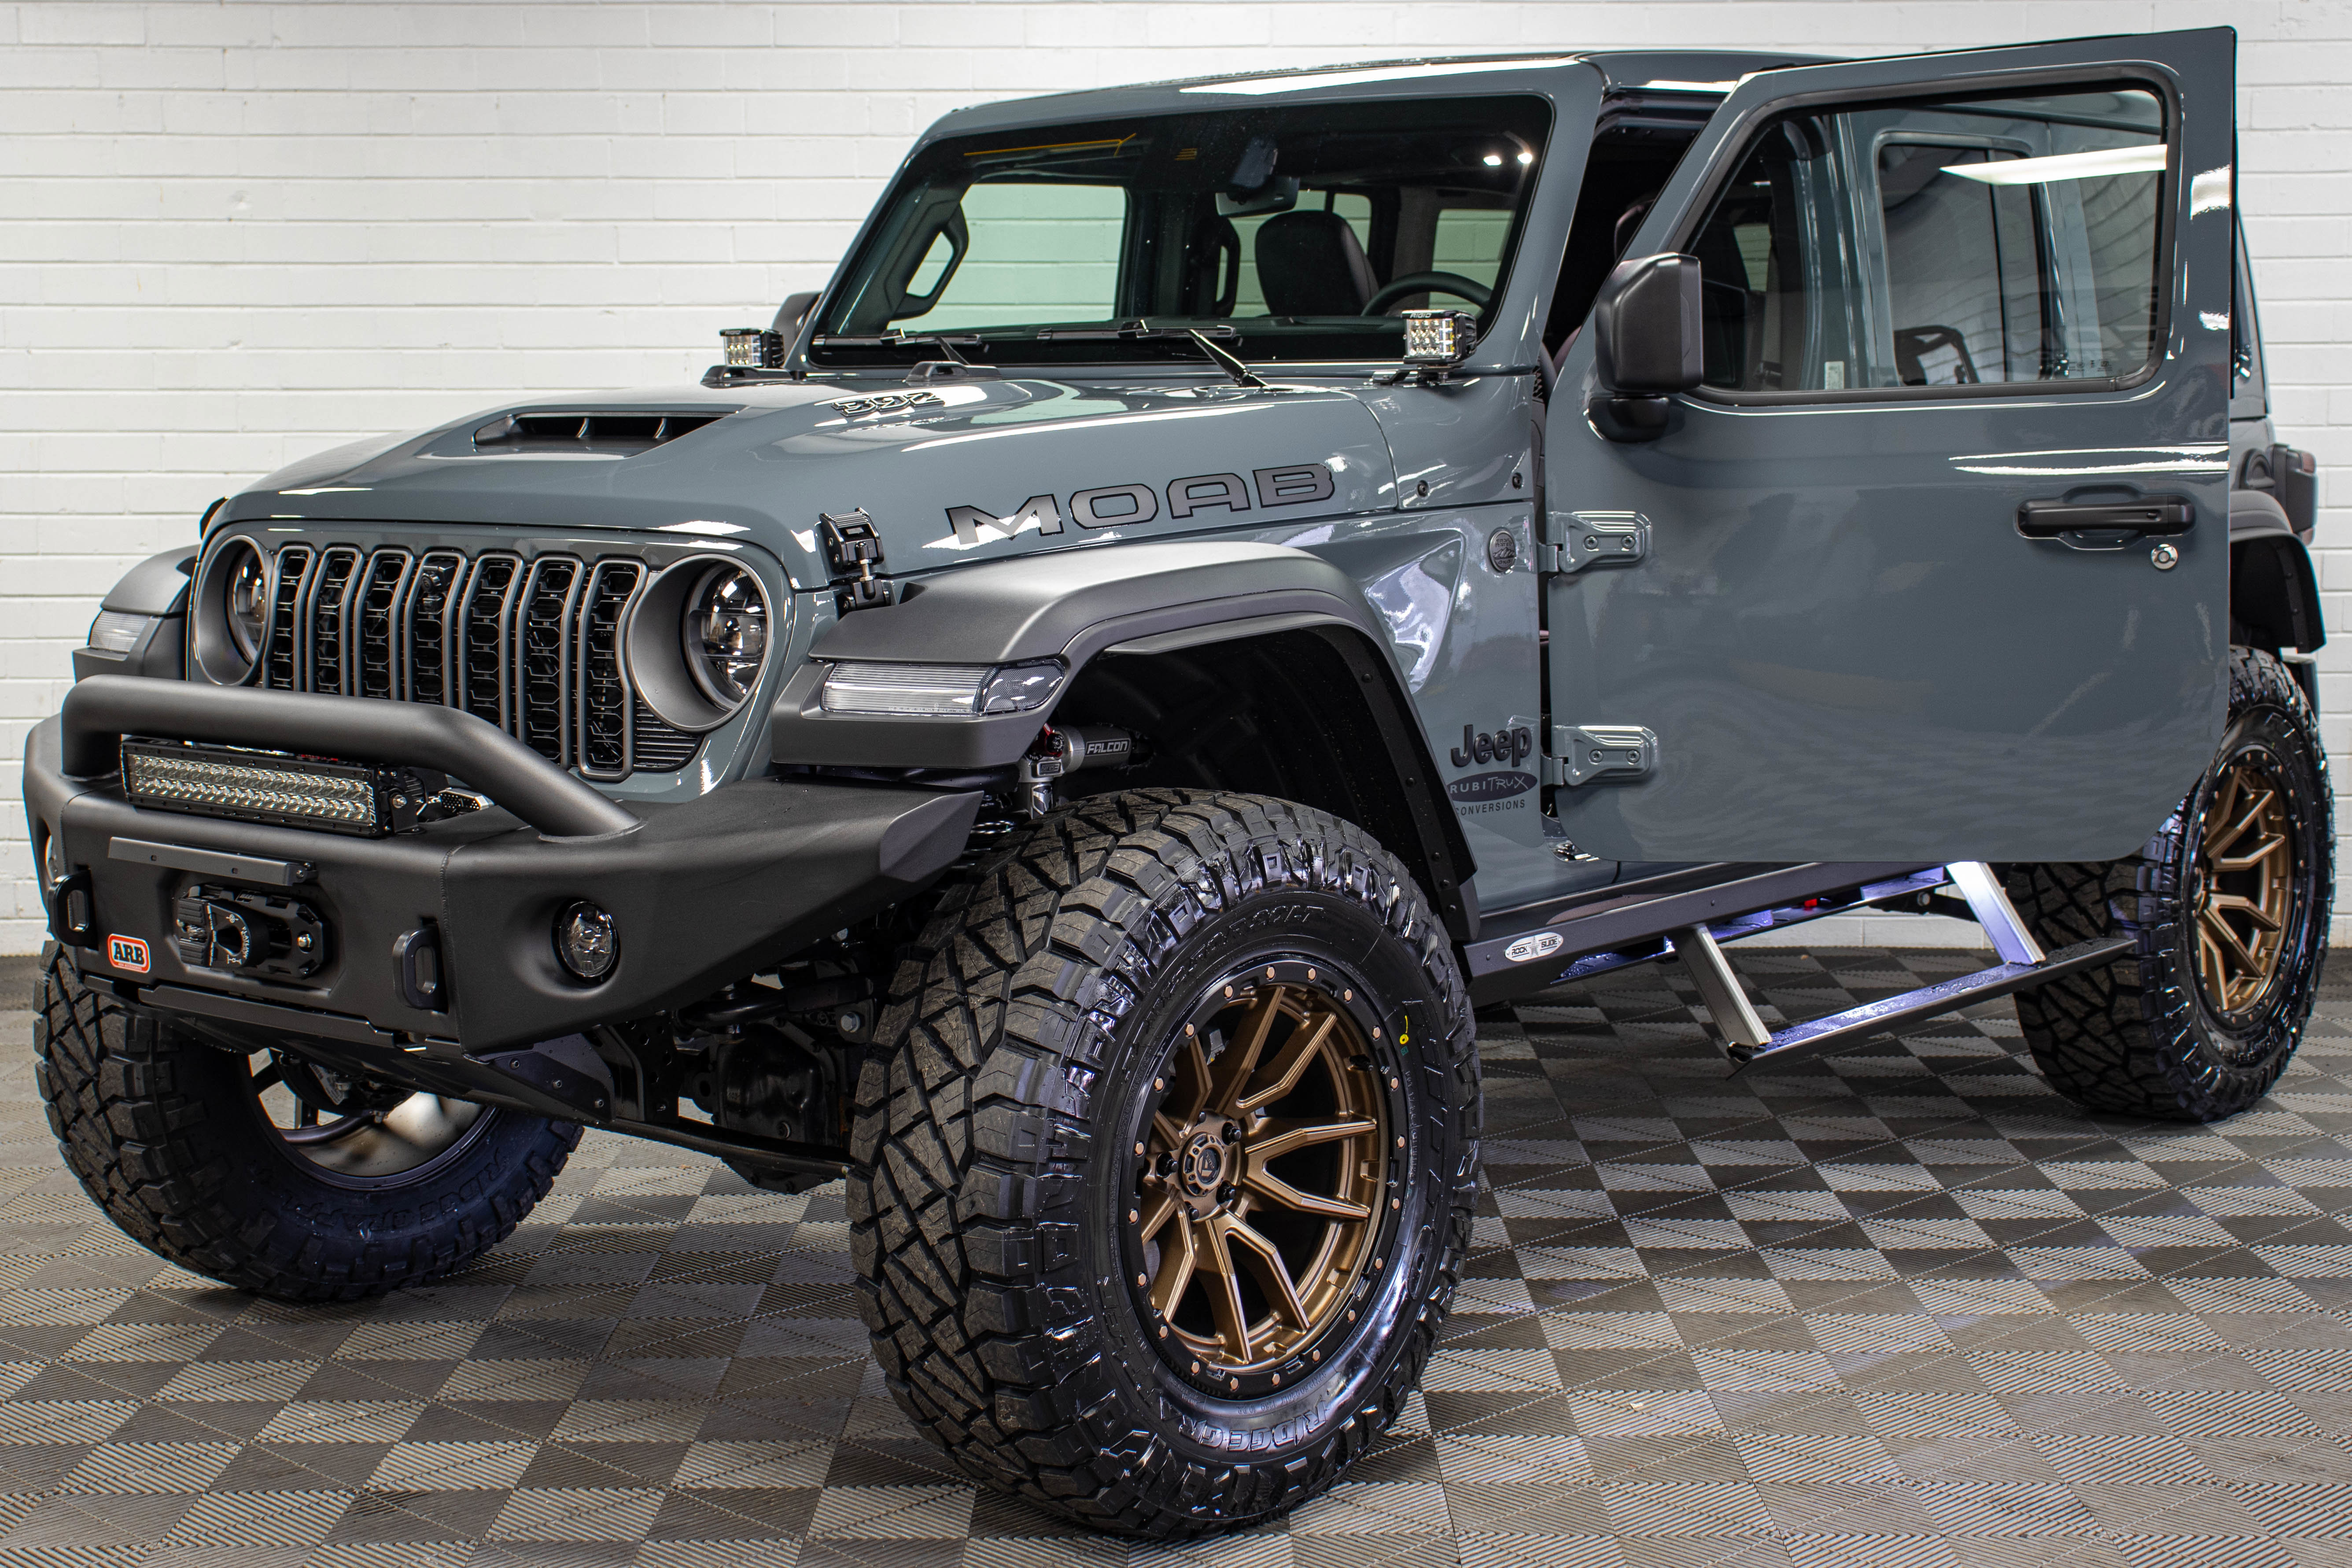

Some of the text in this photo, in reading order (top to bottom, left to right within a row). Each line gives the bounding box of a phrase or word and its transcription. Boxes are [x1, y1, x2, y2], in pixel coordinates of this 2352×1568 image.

[831, 392, 945, 417] 392
[945, 463, 1336, 545] MOAB
[1087, 741, 1128, 754] FALCON
[1450, 724, 1532, 767] Jeep
[366, 785, 376, 823] RIGID
[114, 942, 144, 964] ARB
[1511, 938, 1557, 956] ROCK SLIDE
[1227, 1395, 1328, 1452] RIDGE
